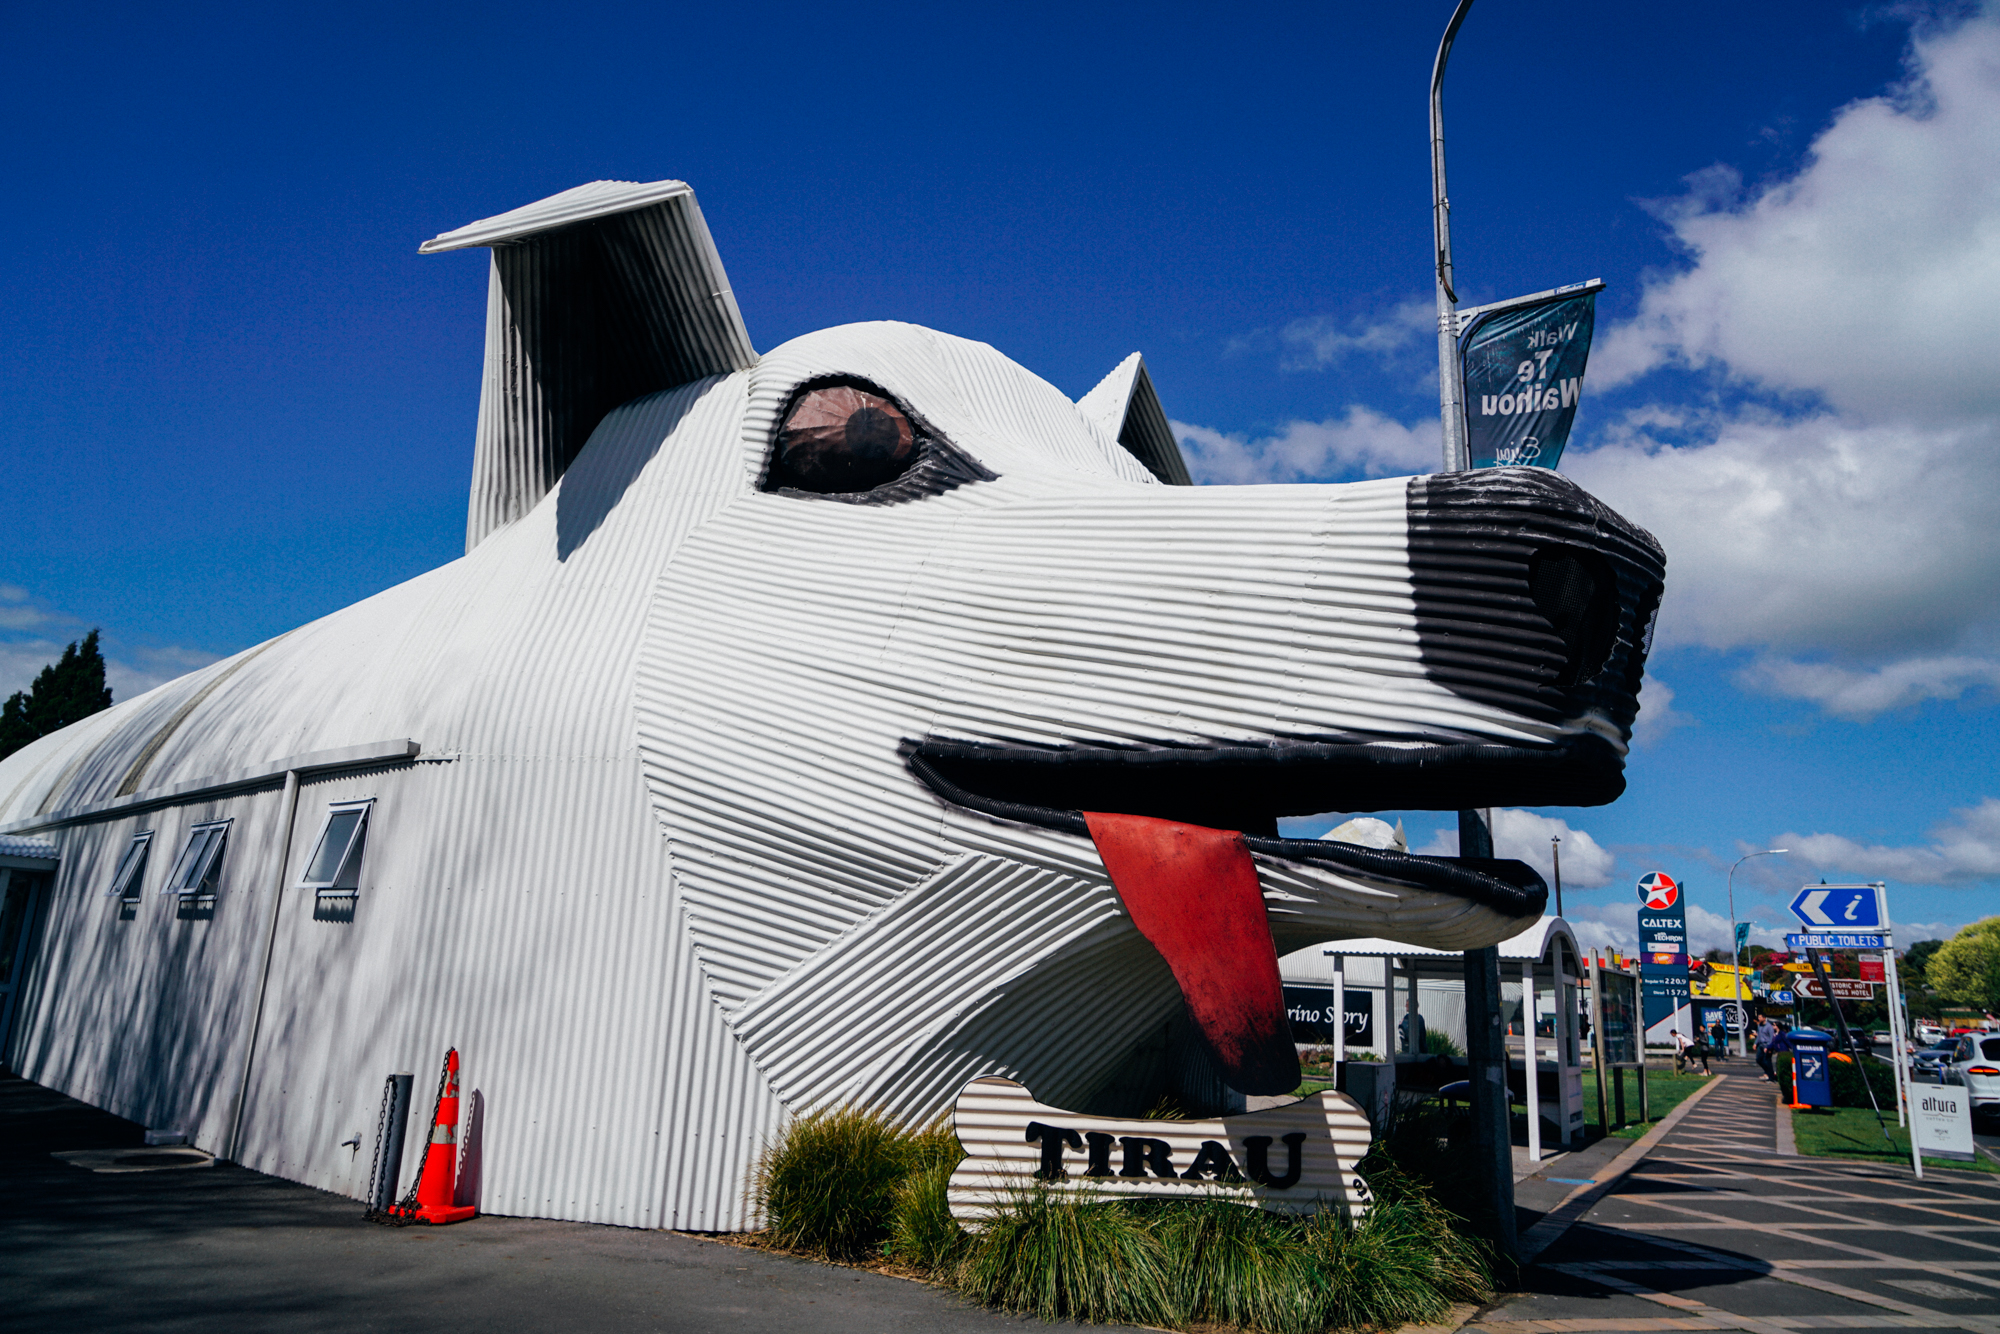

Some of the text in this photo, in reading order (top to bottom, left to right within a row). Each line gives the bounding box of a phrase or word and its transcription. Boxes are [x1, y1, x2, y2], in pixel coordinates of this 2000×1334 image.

[1844, 895, 1863, 920] i
[1641, 918, 1683, 928] CALTEX
[1654, 934, 1683, 942] TECHRON
[1799, 935, 1879, 947] PUBLIC TOILETS
[1726, 965, 1746, 973] STRE
[1287, 1004, 1368, 1033] rino Sory
[1922, 1096, 1957, 1113] altura
[1025, 1121, 1306, 1190] TIRAU
